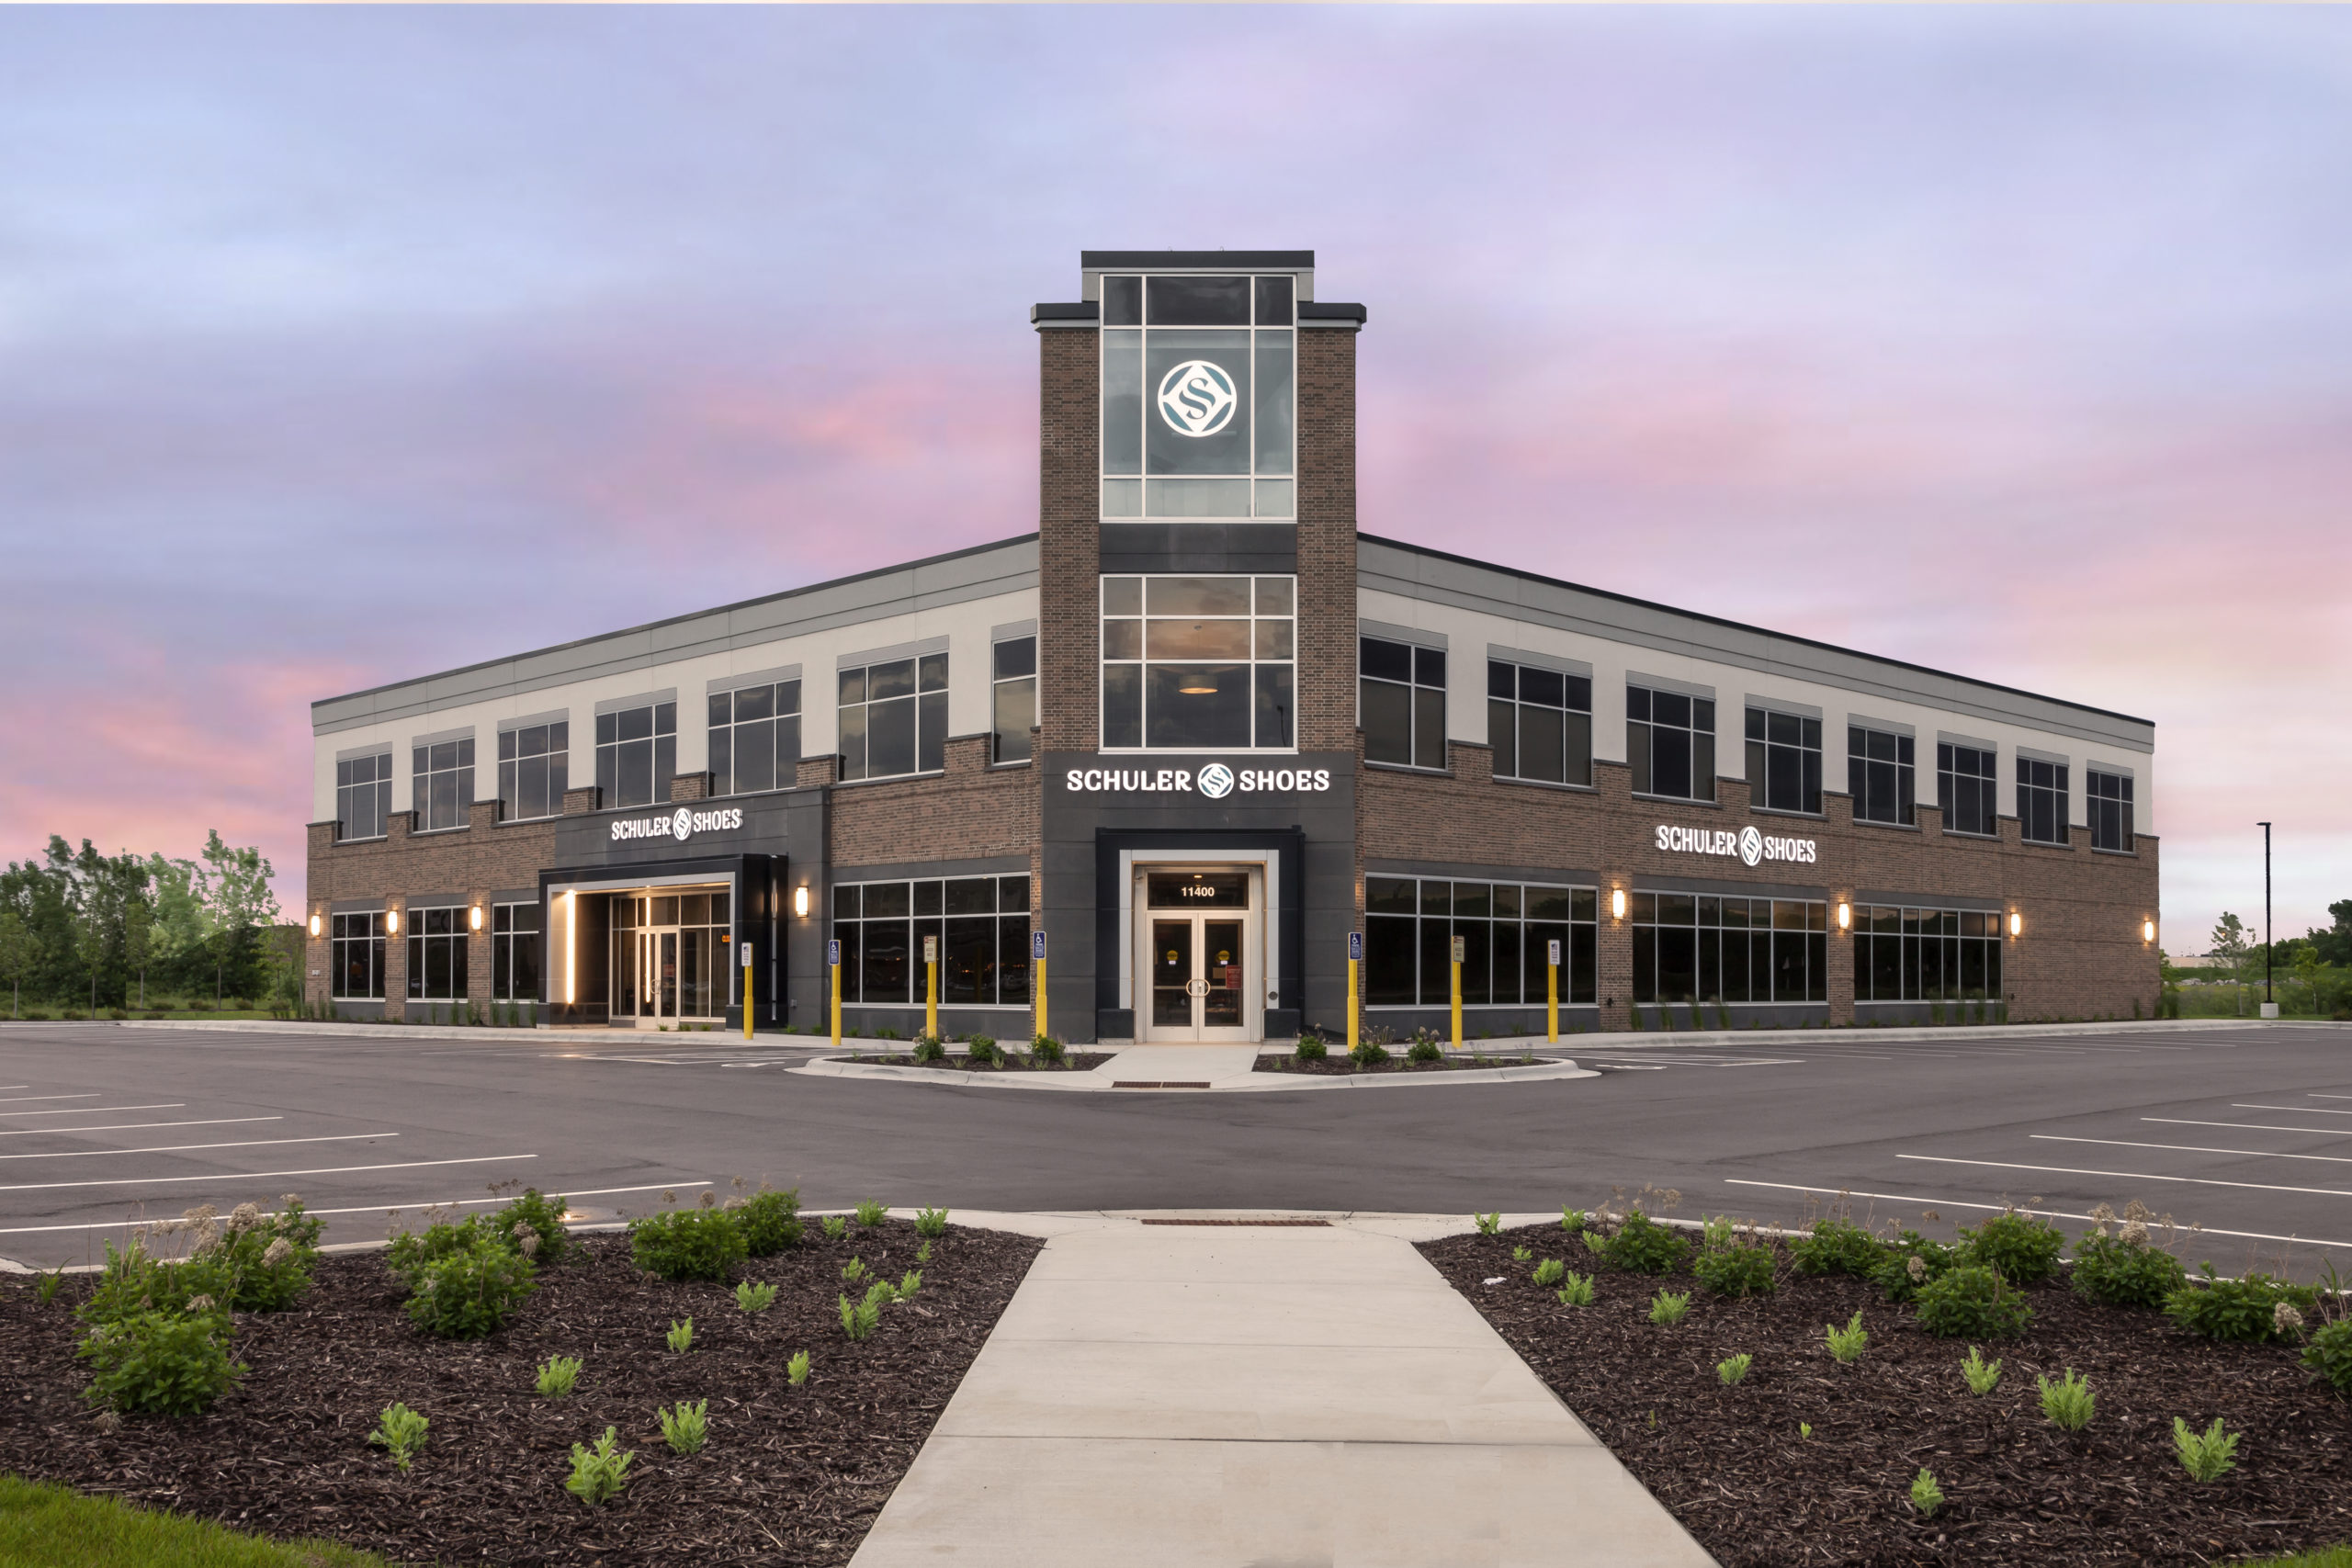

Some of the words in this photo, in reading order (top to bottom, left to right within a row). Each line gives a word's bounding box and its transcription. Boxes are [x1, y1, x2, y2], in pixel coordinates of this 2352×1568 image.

[1066, 769, 1193, 792] SCHULER
[1239, 769, 1330, 792] SHOES
[611, 817, 672, 840] SCHULER
[695, 808, 742, 832] SHOES
[1655, 825, 1738, 857] SCHULER
[1763, 836, 1816, 863] SHOES
[1182, 886, 1215, 897] 11400
